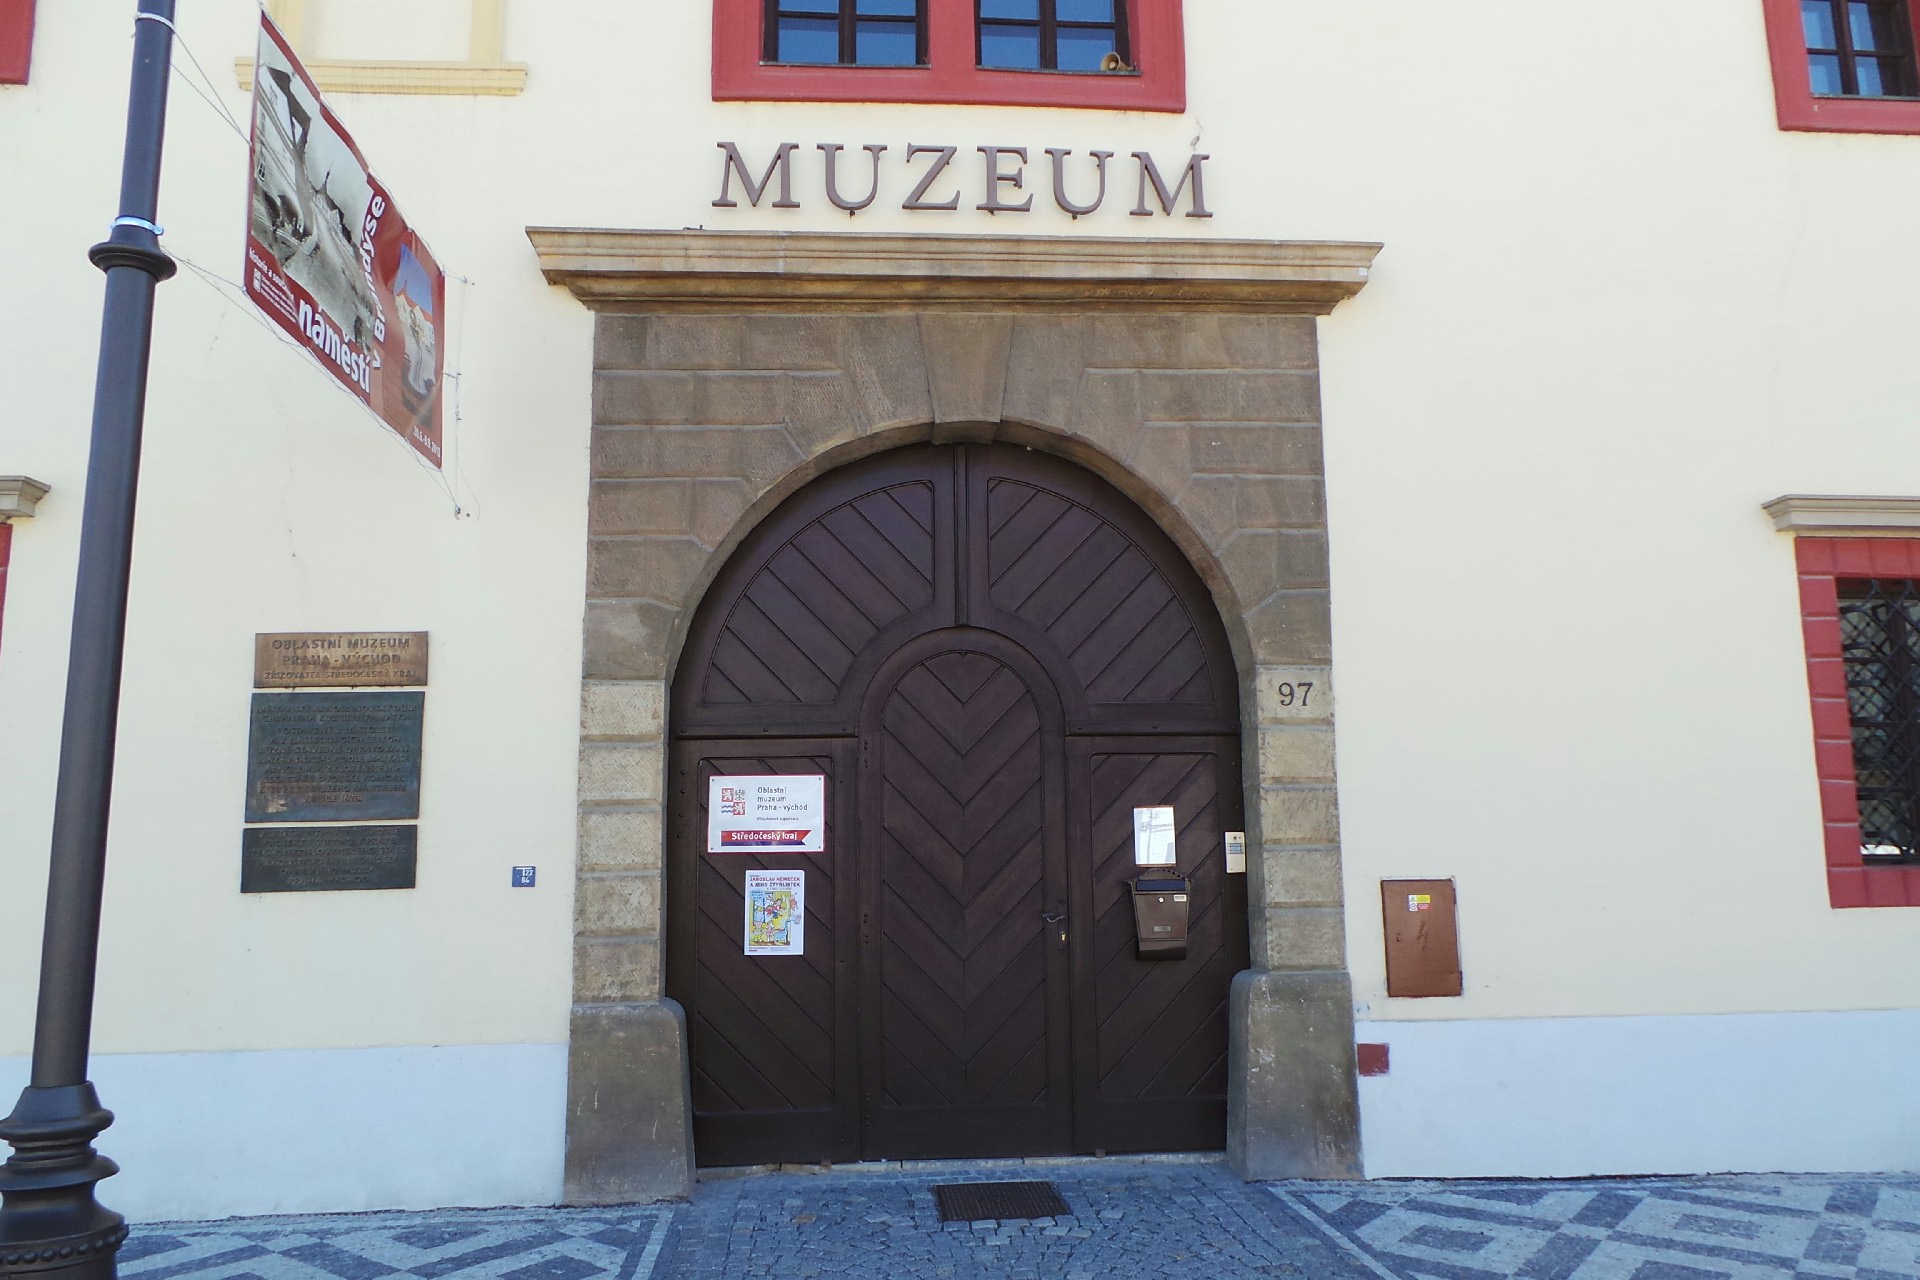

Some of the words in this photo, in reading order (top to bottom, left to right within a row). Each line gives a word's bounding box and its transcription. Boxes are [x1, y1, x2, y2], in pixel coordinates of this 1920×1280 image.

[711, 141, 1214, 218] MUZEUM
[299, 299, 370, 393] náměstí
[271, 636, 343, 650] OBLASTNÍ
[347, 638, 410, 650] MUZEUM
[282, 655, 331, 666] PRAHA
[342, 652, 402, 665] VÝCHOD
[264, 669, 321, 680] ZŘIZOVATEL
[326, 668, 388, 679] STŘEDOČESKÝ
[393, 670, 417, 678] KRAJ
[1279, 682, 1313, 706] 97
[757, 786, 787, 794] Oblastní
[783, 803, 808, 812] východ
[731, 831, 781, 841] Středočeský
[782, 831, 798, 841] kraj
